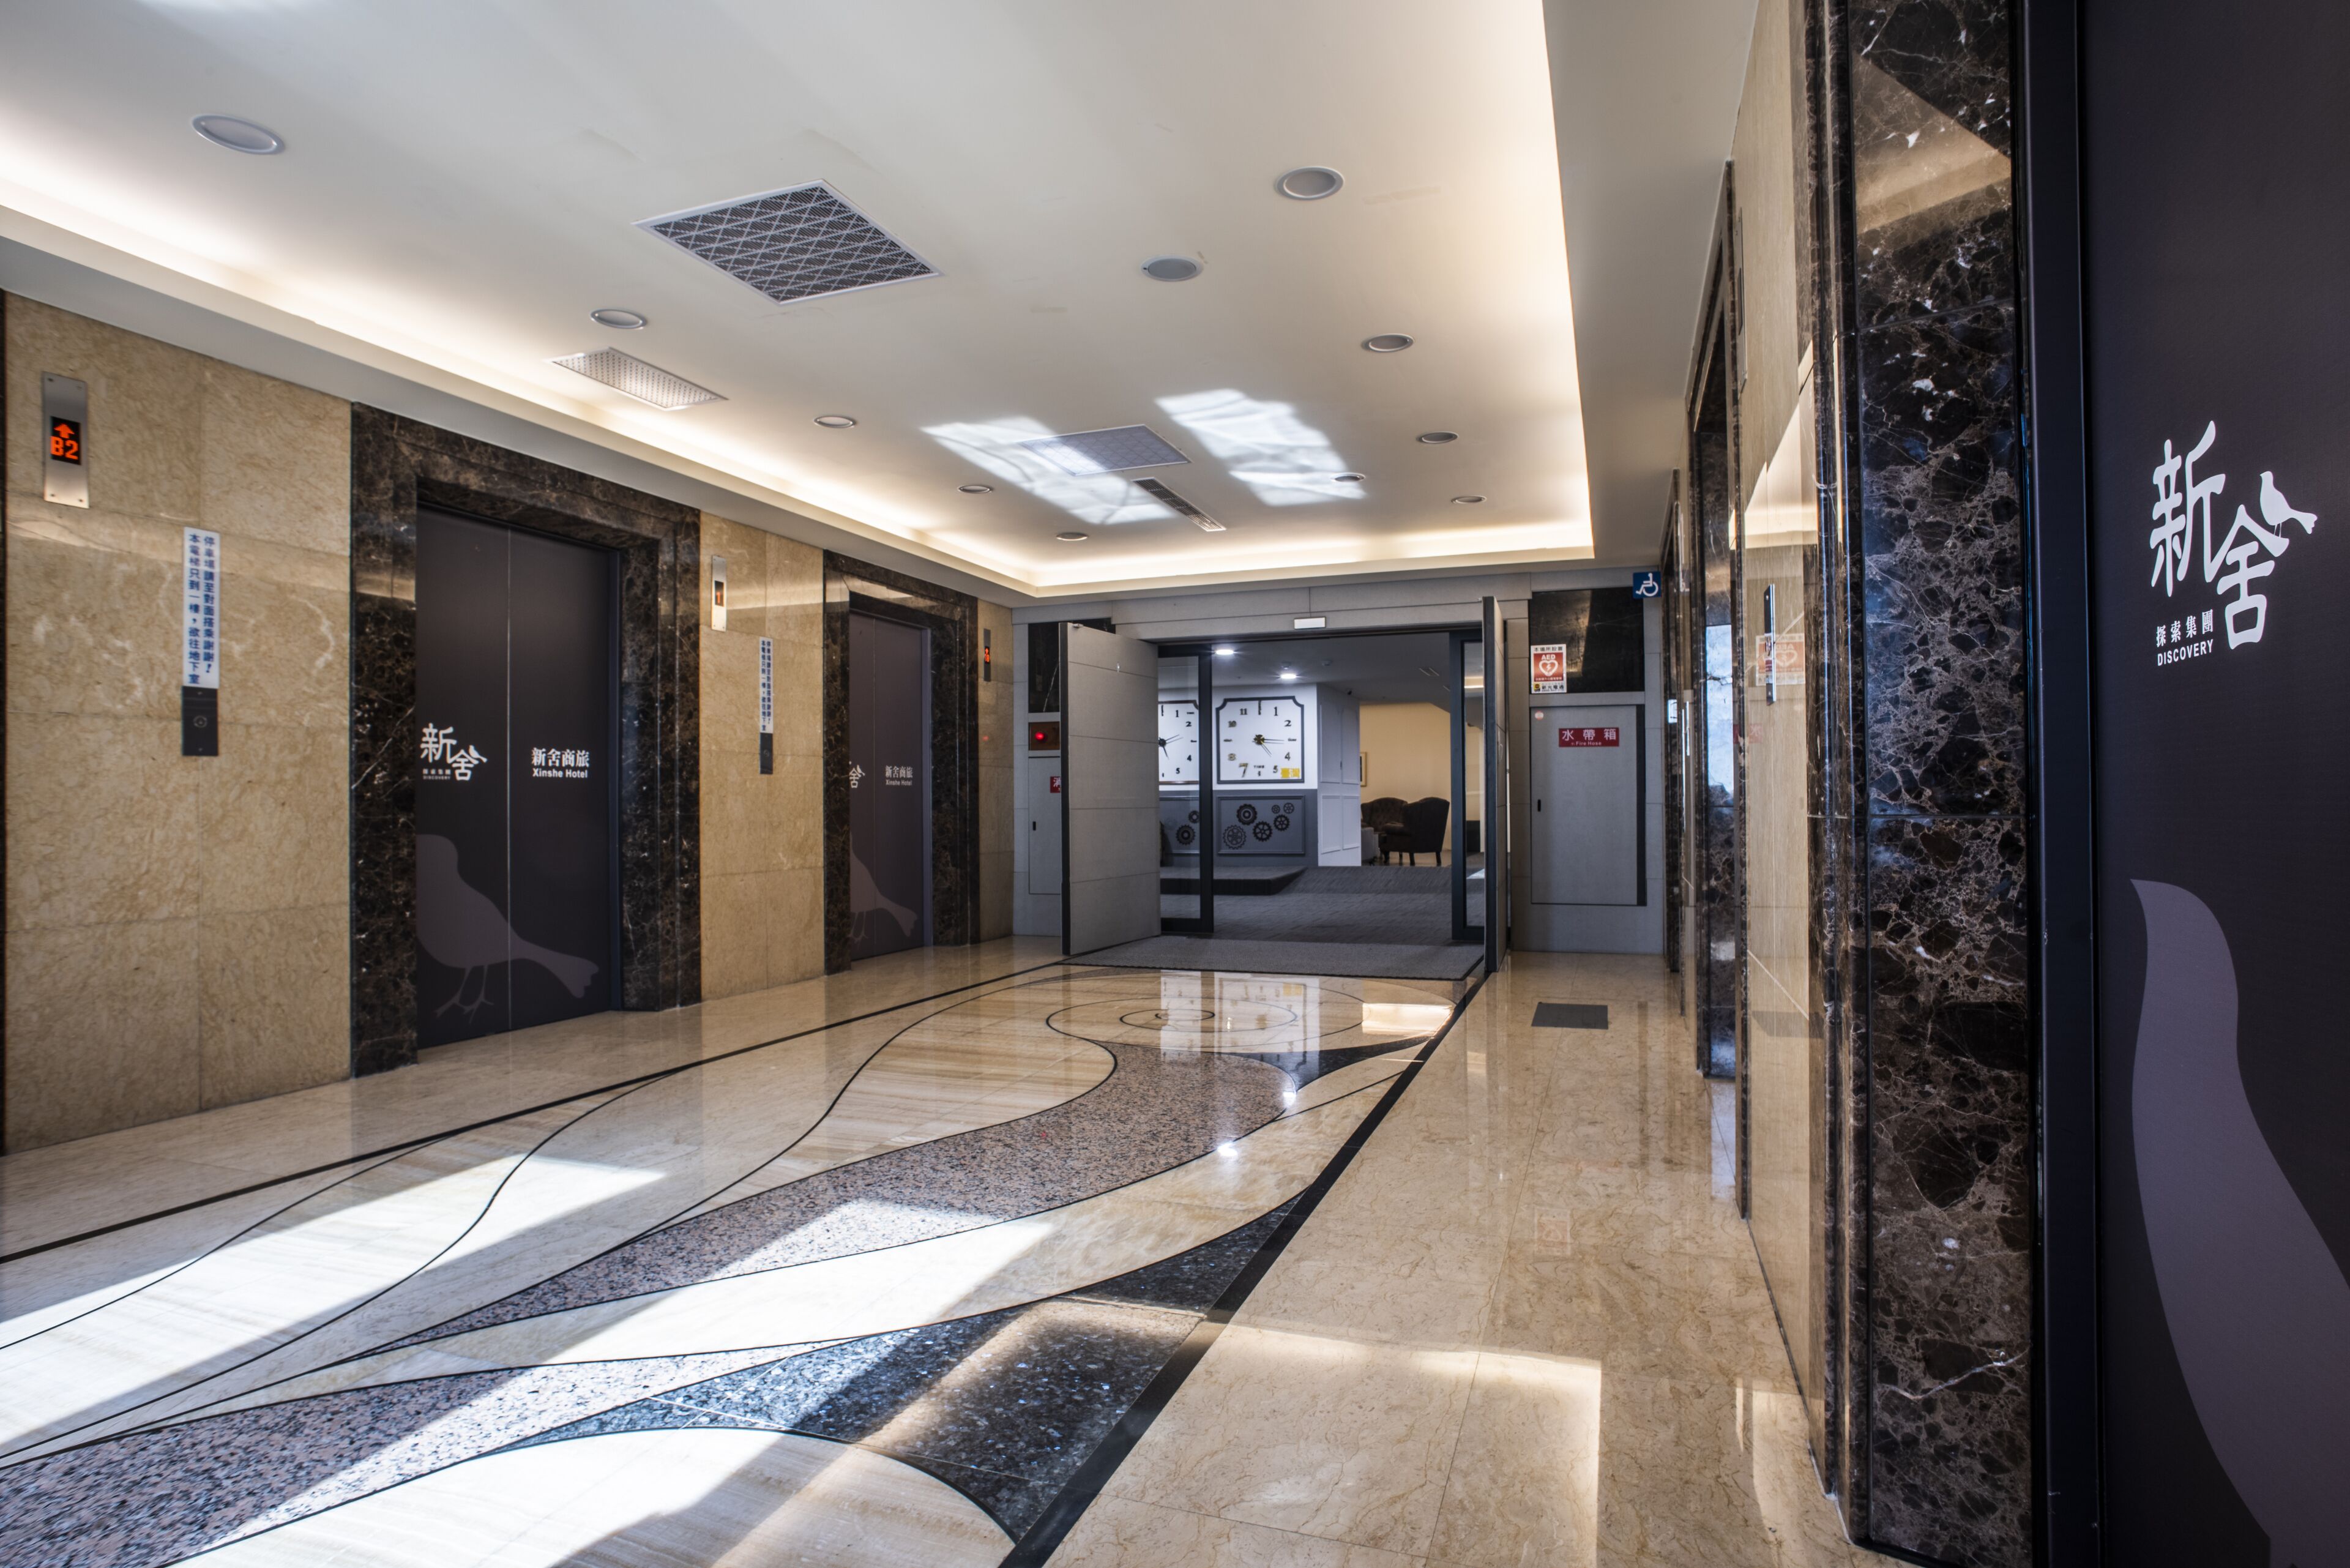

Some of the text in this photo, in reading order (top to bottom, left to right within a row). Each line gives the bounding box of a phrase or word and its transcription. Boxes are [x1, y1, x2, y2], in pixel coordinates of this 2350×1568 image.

[50, 436, 78, 460] B2
[2149, 420, 2290, 650] 新舍
[716, 591, 721, 604] 1
[2155, 608, 2214, 648] 探索集團
[2157, 638, 2214, 666] DISCOVERY
[1274, 706, 1278, 716] 1
[1562, 728, 1616, 742] 水帶箱
[420, 723, 479, 782] 新舍
[531, 747, 589, 767] 新舍商旅
[1285, 752, 1291, 761] 4
[532, 768, 588, 778] Xinshe Hotel
[849, 761, 862, 788] 舍
[1239, 763, 1248, 778] 7
[1273, 765, 1278, 774] 5
